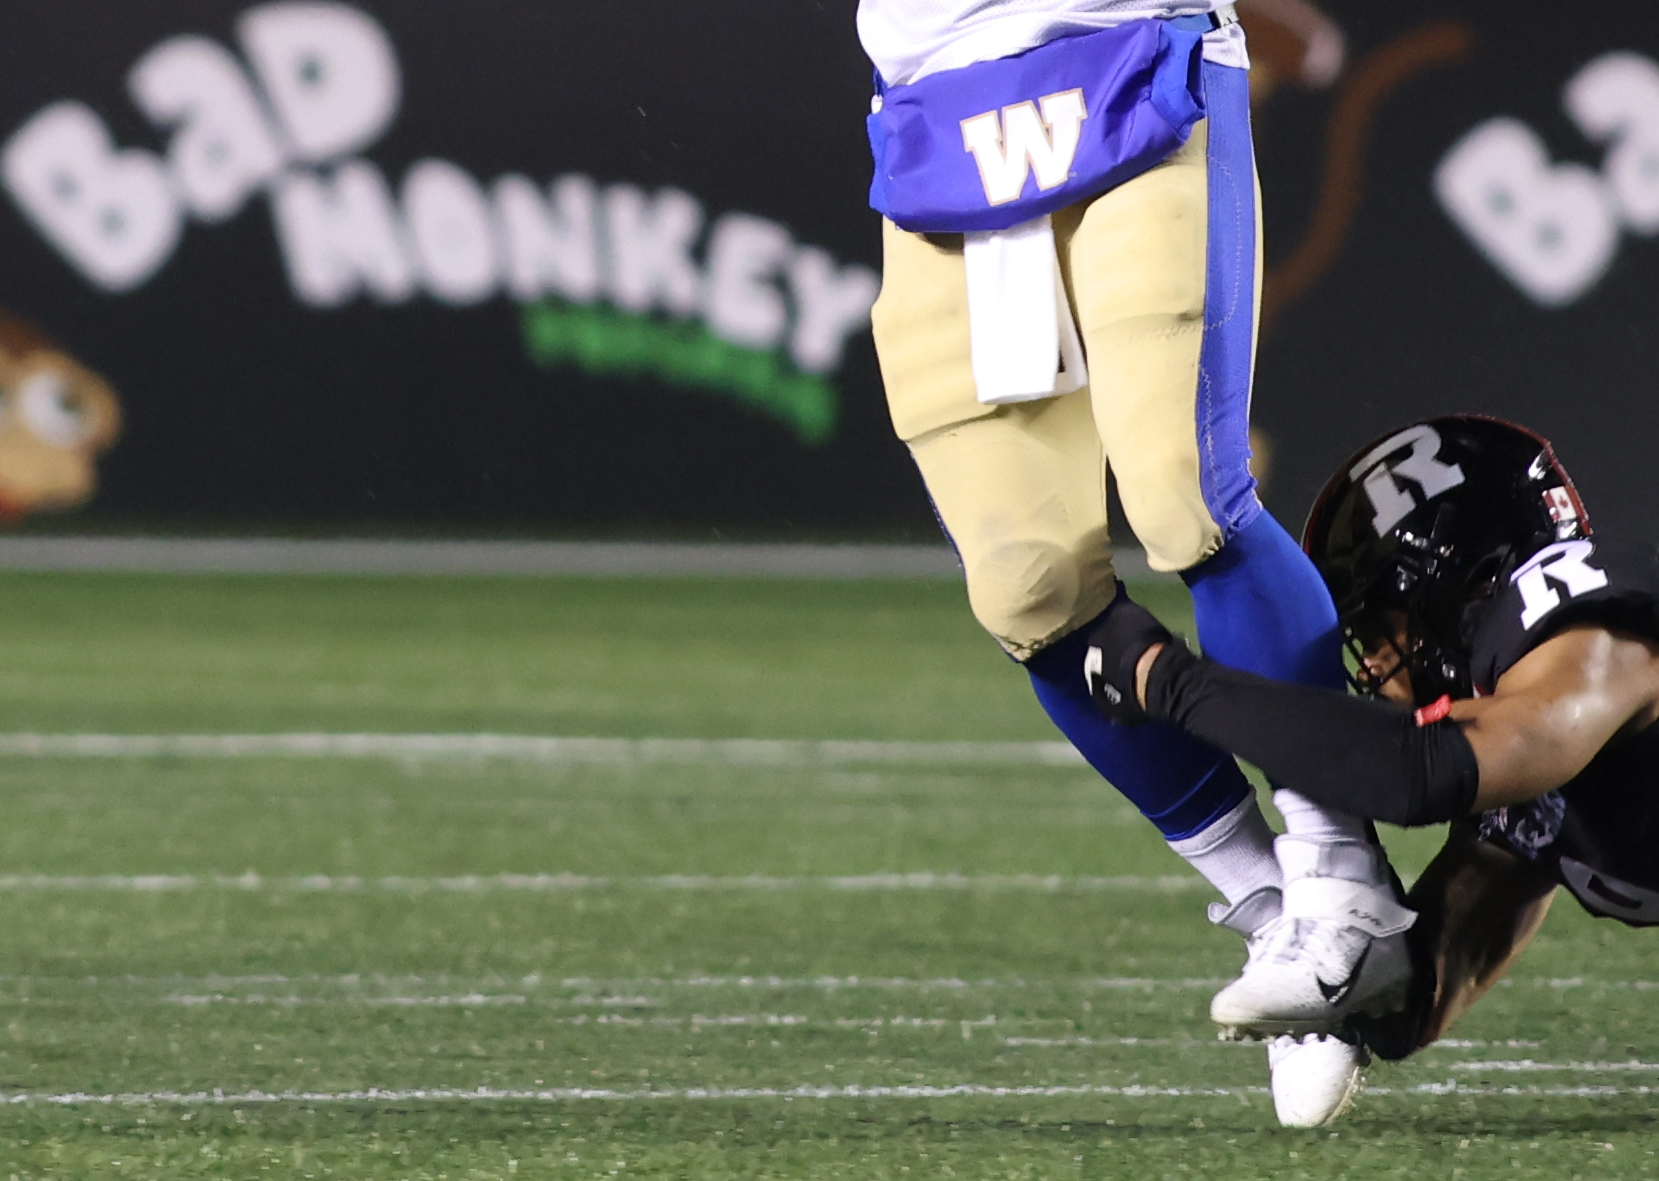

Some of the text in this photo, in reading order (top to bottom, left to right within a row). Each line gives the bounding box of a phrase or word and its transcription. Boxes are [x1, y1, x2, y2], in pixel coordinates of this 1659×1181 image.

[959, 87, 1088, 207] W
[270, 156, 880, 376] MONKEY
[1350, 423, 1465, 538] R
[1509, 539, 1608, 631] R
